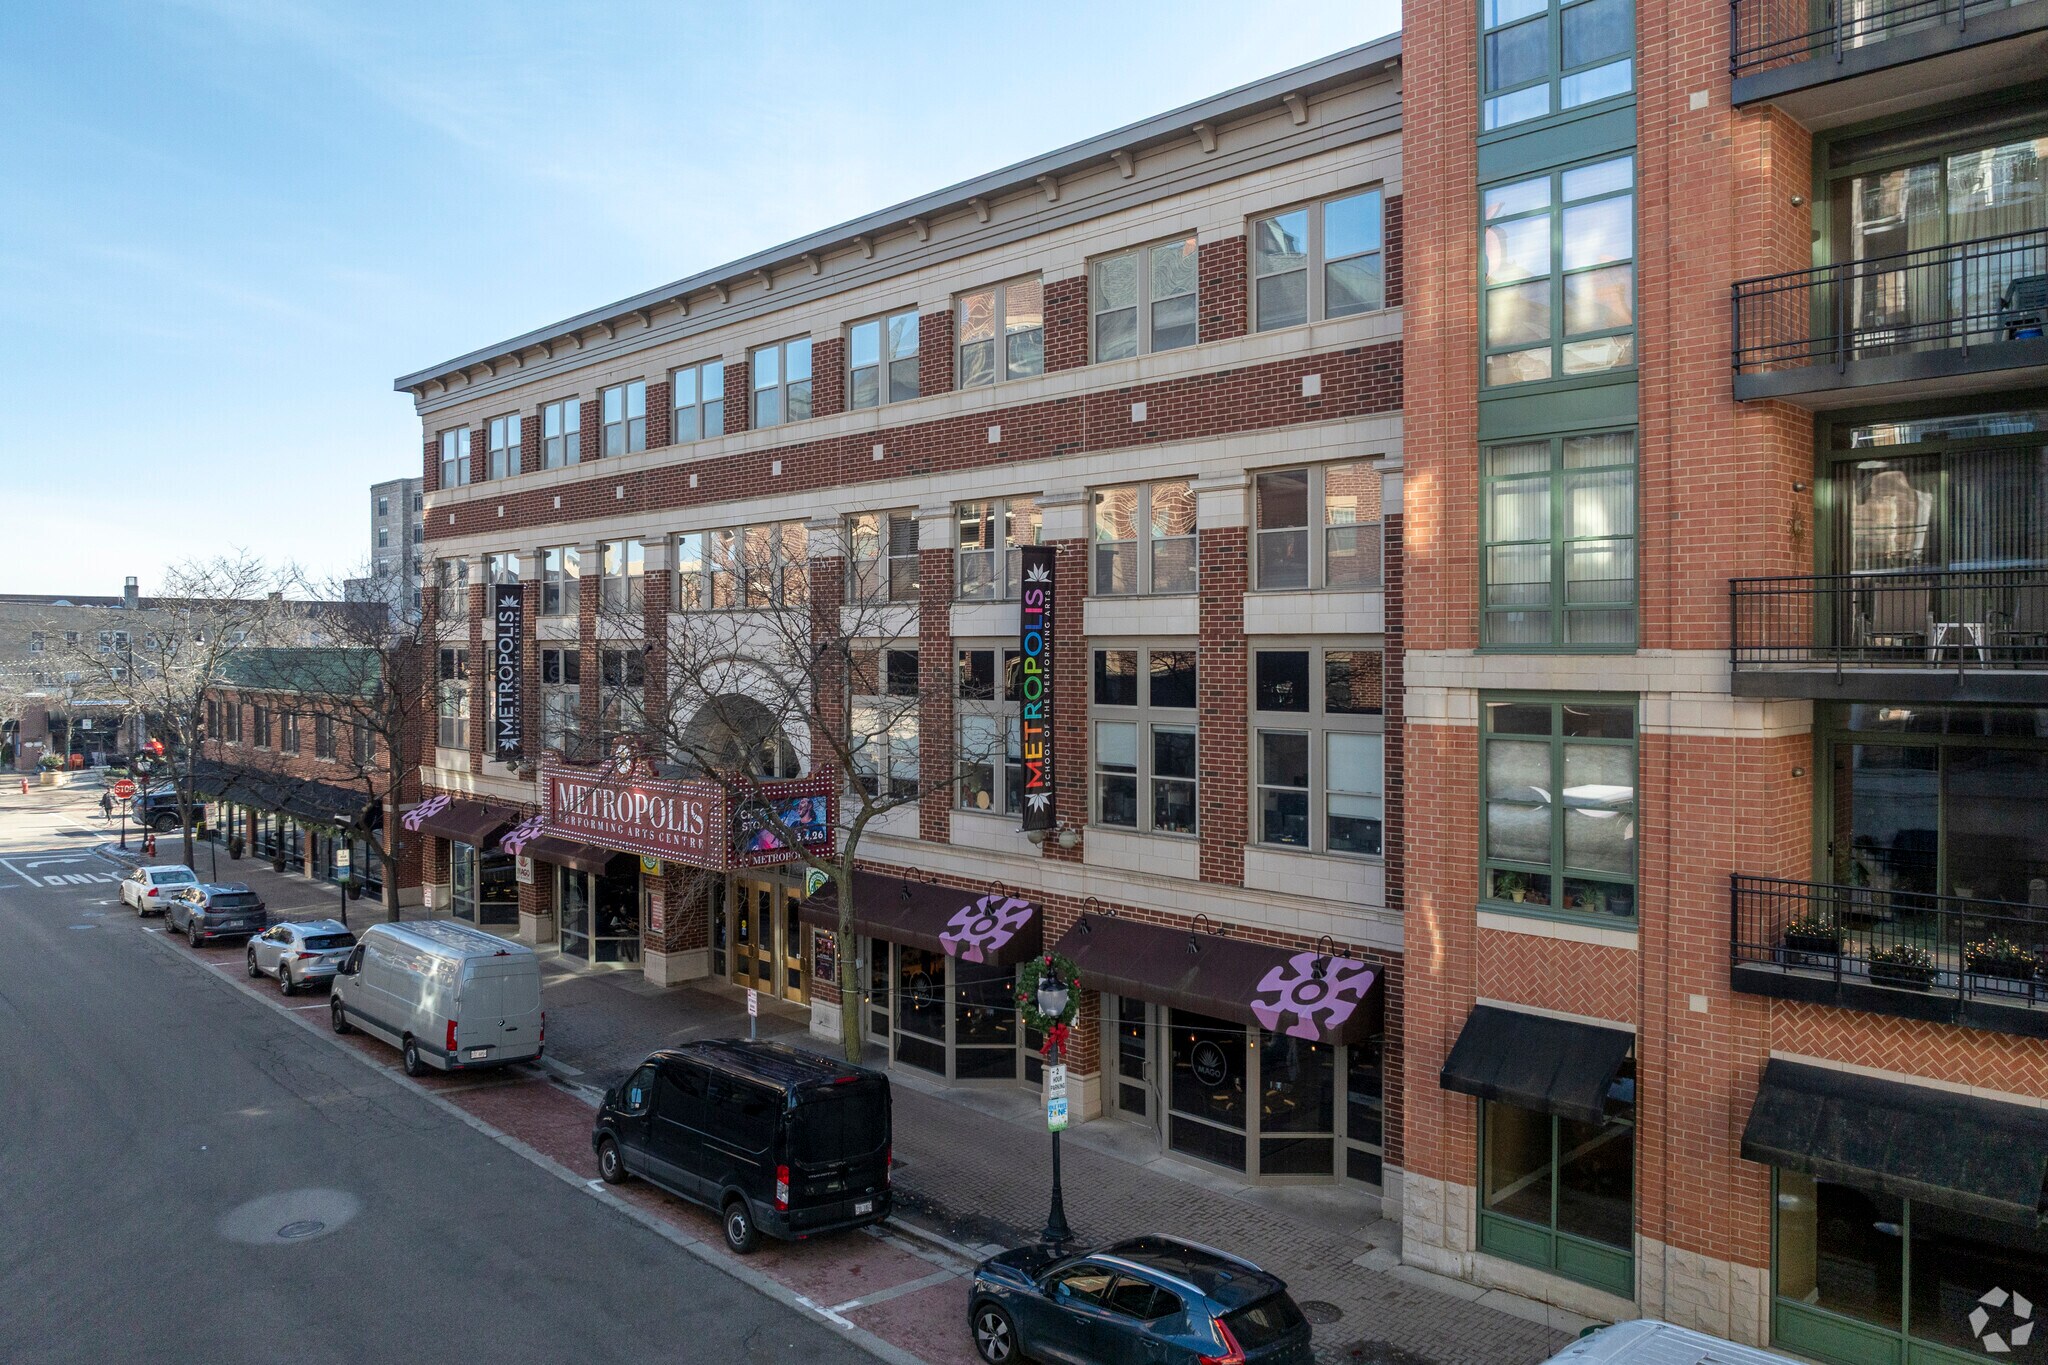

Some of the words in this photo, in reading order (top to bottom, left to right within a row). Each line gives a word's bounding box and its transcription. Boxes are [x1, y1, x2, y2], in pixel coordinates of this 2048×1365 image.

[498, 611, 514, 735] METROPOLIS
[1023, 588, 1044, 788] METROPOLIS
[1044, 724, 1050, 738] OF
[115, 785, 134, 793] STOP
[558, 782, 705, 836] METROPOLIS
[628, 826, 655, 841] ARTS
[659, 832, 704, 850] CENTRE
[43, 871, 123, 886] ONLY
[1197, 1065, 1221, 1078] MAGO
